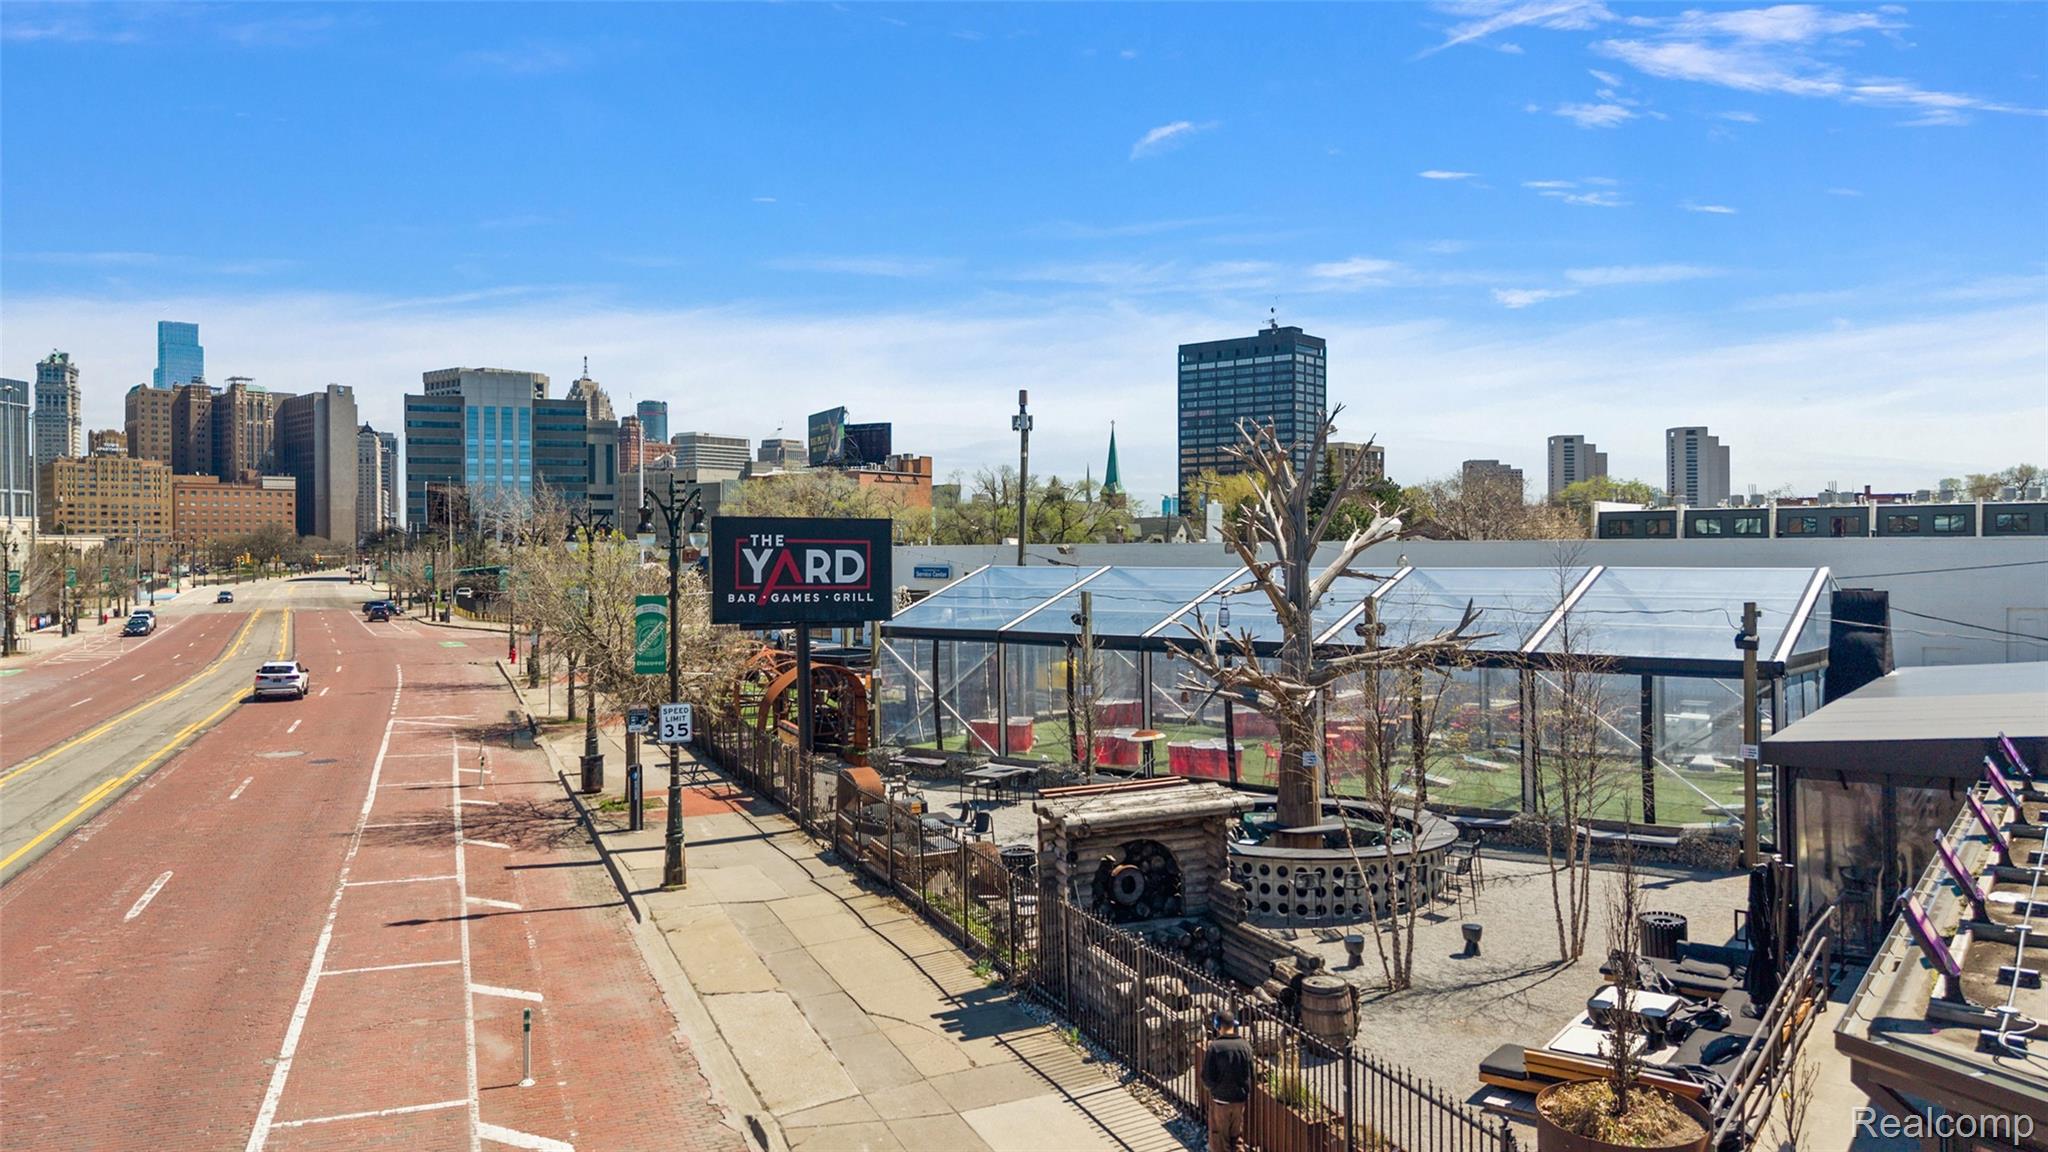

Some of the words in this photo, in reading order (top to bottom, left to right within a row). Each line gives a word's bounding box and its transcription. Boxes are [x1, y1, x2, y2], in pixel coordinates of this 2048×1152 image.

[750, 534, 784, 547] THE
[742, 548, 865, 606] YARD
[728, 593, 756, 603] BAR
[771, 593, 820, 602] GAMES
[833, 593, 874, 602] GRILL
[663, 707, 689, 715] SPEED
[664, 723, 689, 737] 35
